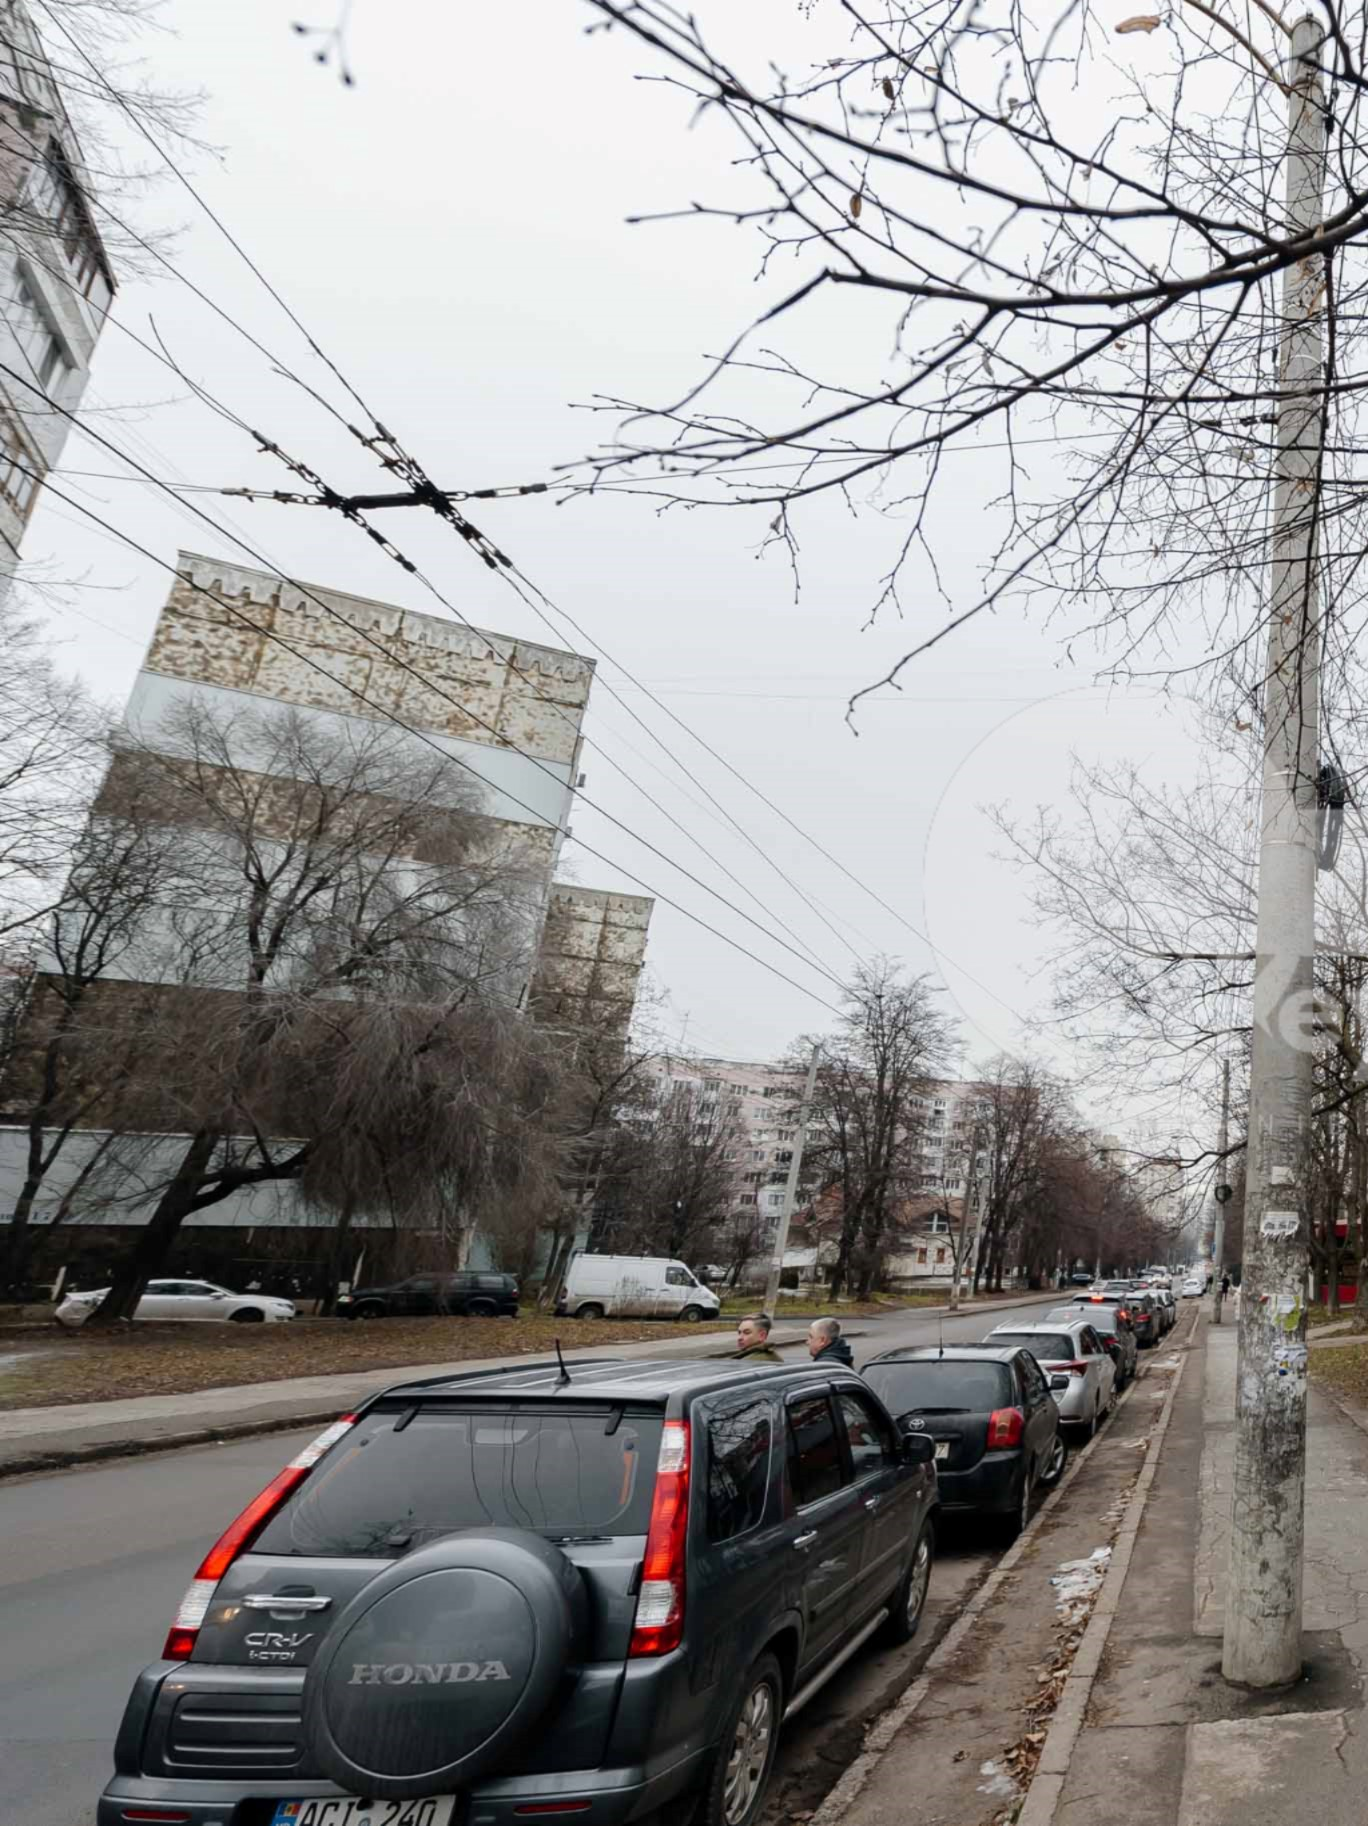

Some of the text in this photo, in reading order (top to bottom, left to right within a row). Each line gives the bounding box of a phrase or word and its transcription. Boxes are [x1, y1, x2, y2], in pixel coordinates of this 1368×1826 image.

[244, 1632, 315, 1647] CR-V
[347, 1660, 511, 1685] HONDA
[380, 1799, 438, 1826] 240
